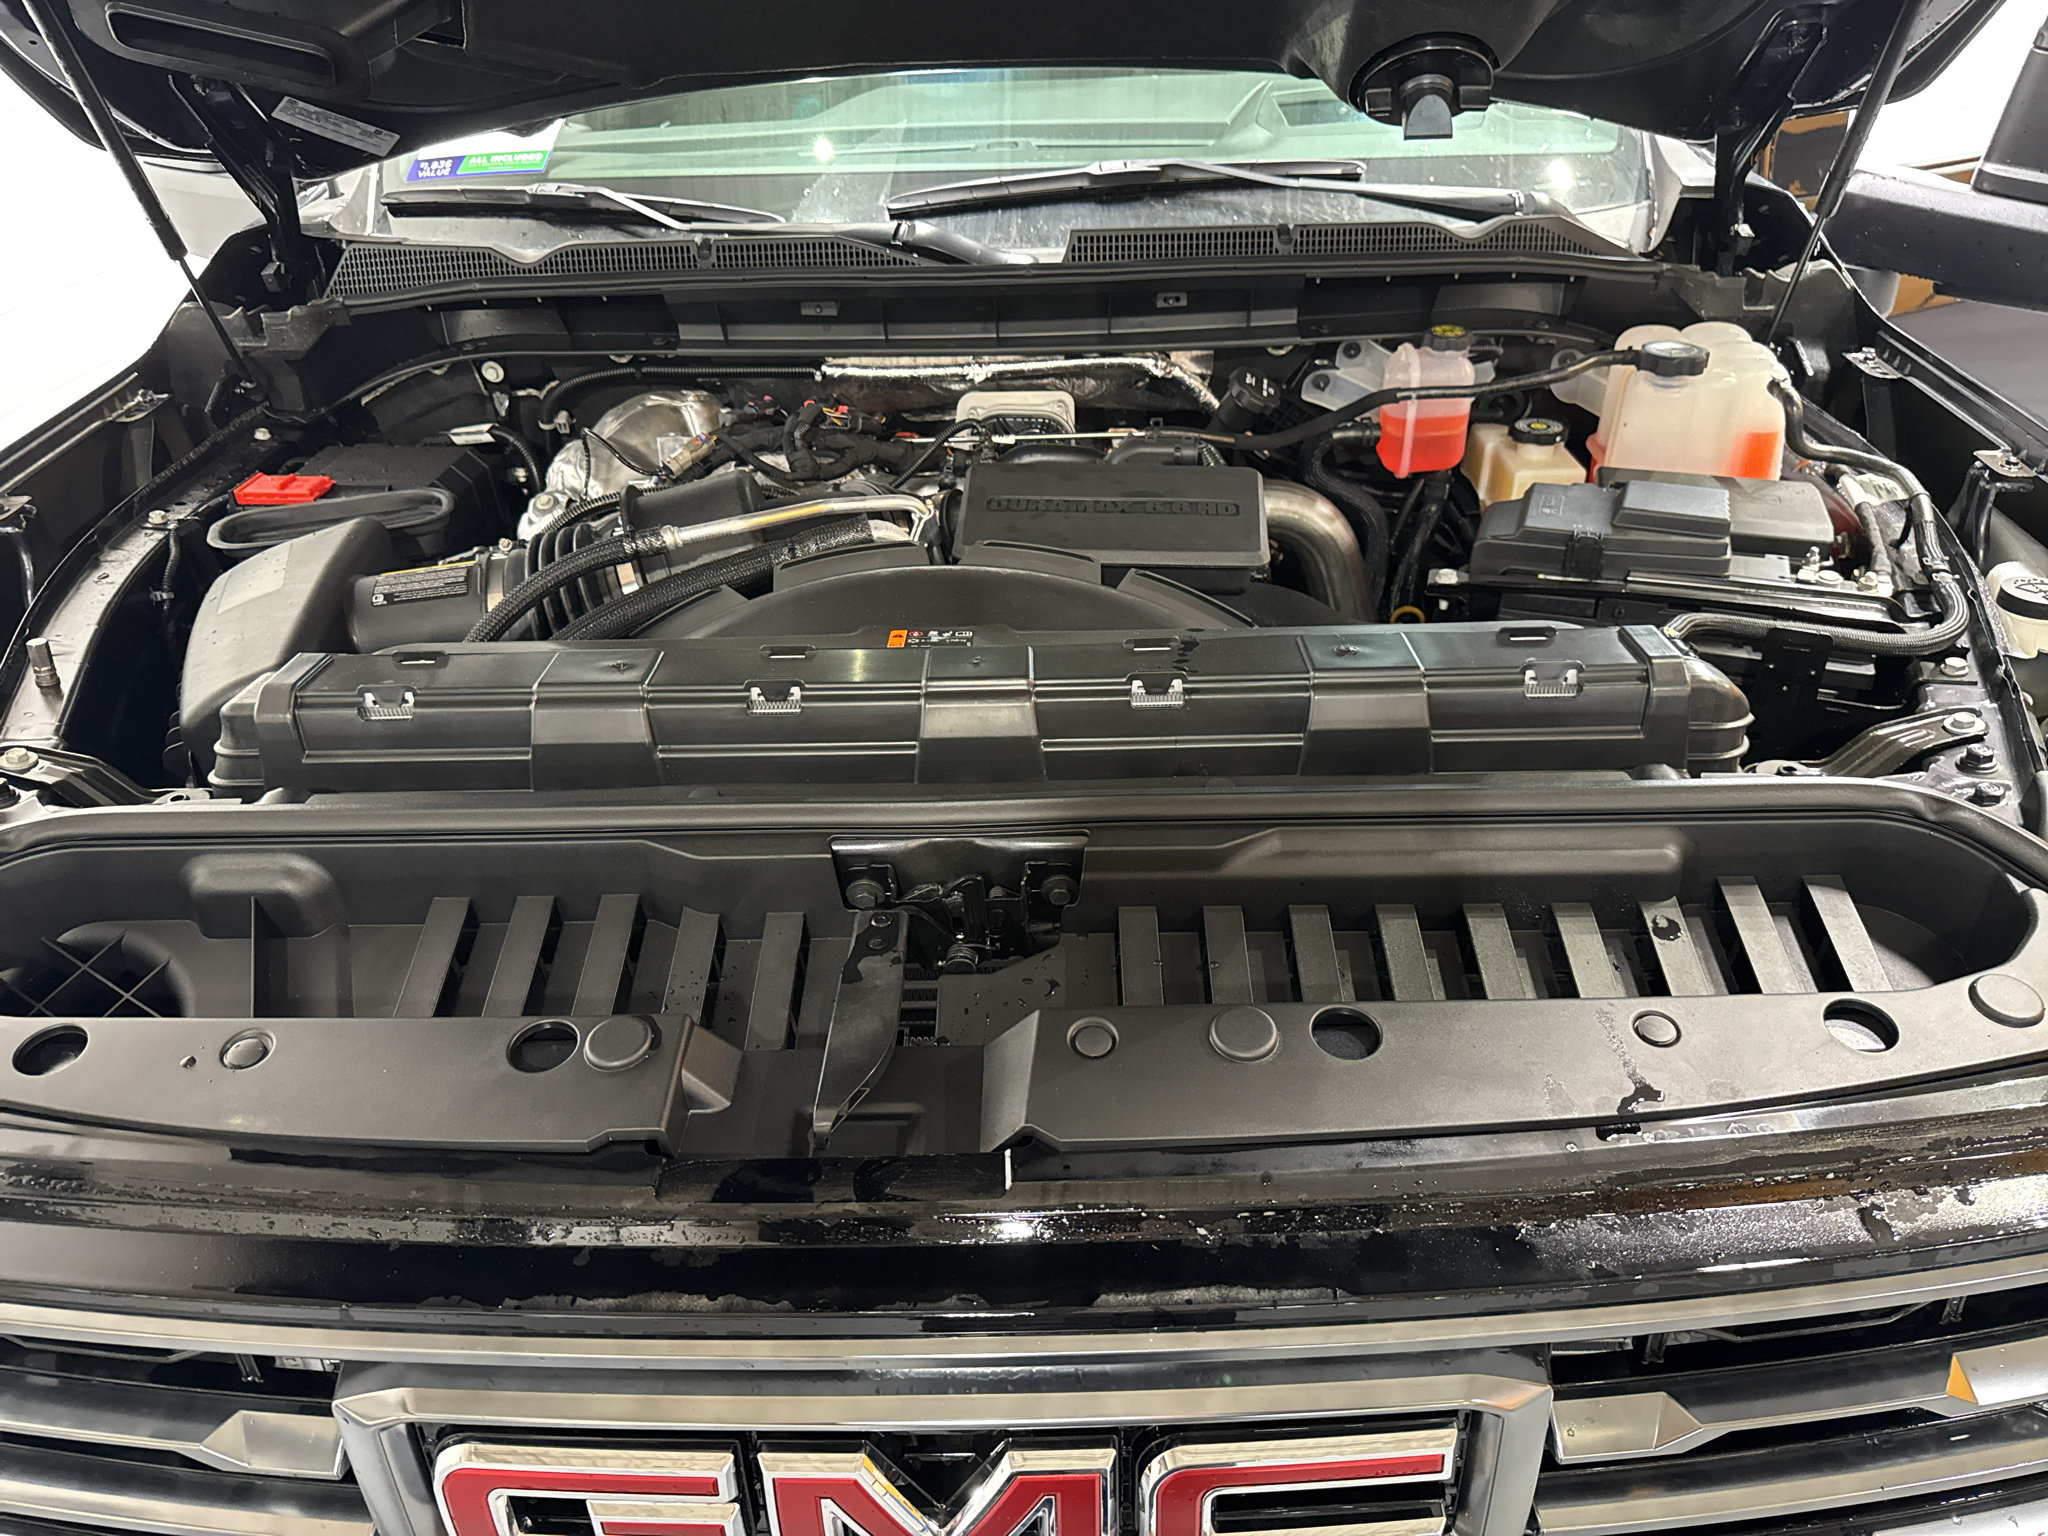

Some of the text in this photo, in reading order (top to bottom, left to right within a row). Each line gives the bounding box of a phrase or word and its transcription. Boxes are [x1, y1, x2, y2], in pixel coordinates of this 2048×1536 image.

[468, 152, 543, 164] ALL INCLUDED
[417, 167, 451, 178] VALUE
[988, 498, 1134, 513] DURAMAX
[1197, 501, 1238, 515] HD
